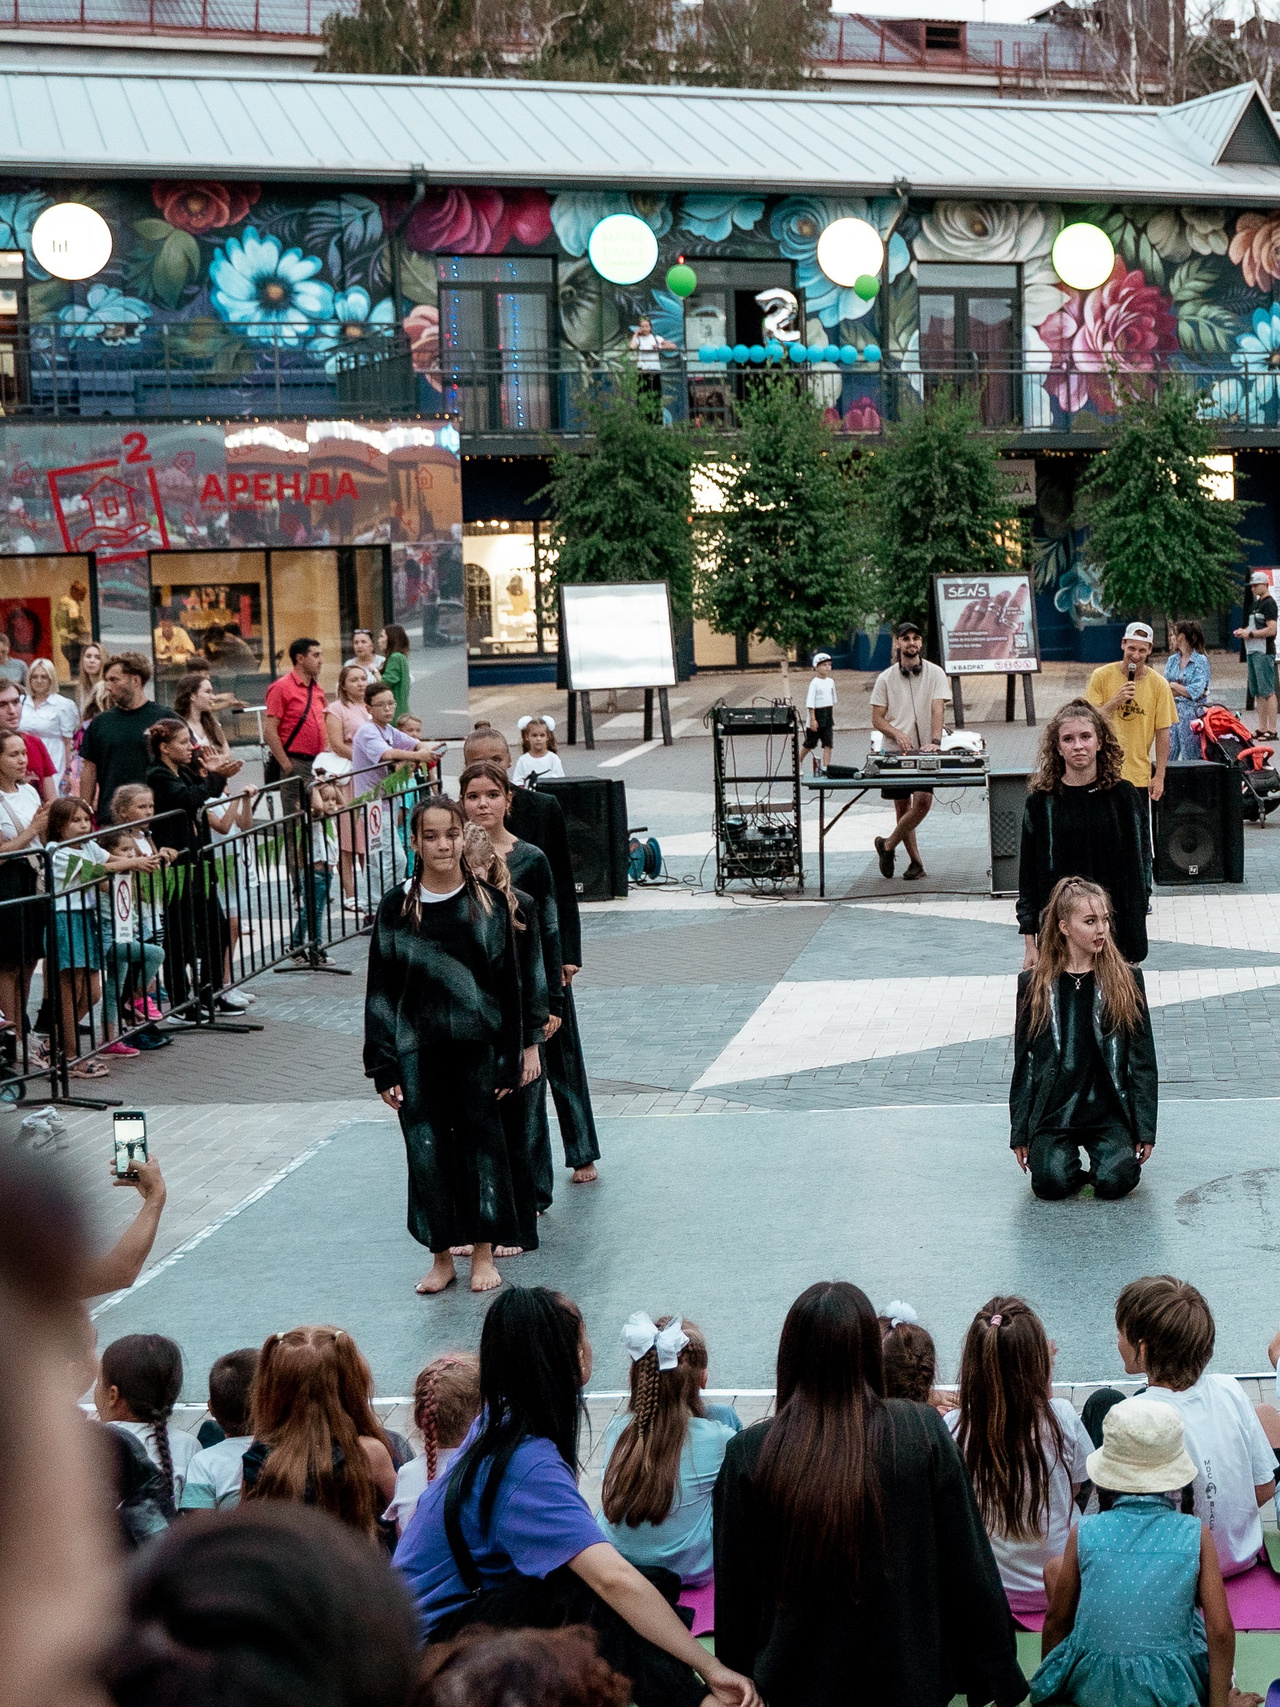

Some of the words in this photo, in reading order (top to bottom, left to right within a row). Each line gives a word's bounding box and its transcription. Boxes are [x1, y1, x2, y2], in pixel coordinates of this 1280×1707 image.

[201, 472, 361, 506] АРЕНДА
[948, 583, 988, 598] SENS
[1204, 1459, 1213, 1480] MDC
